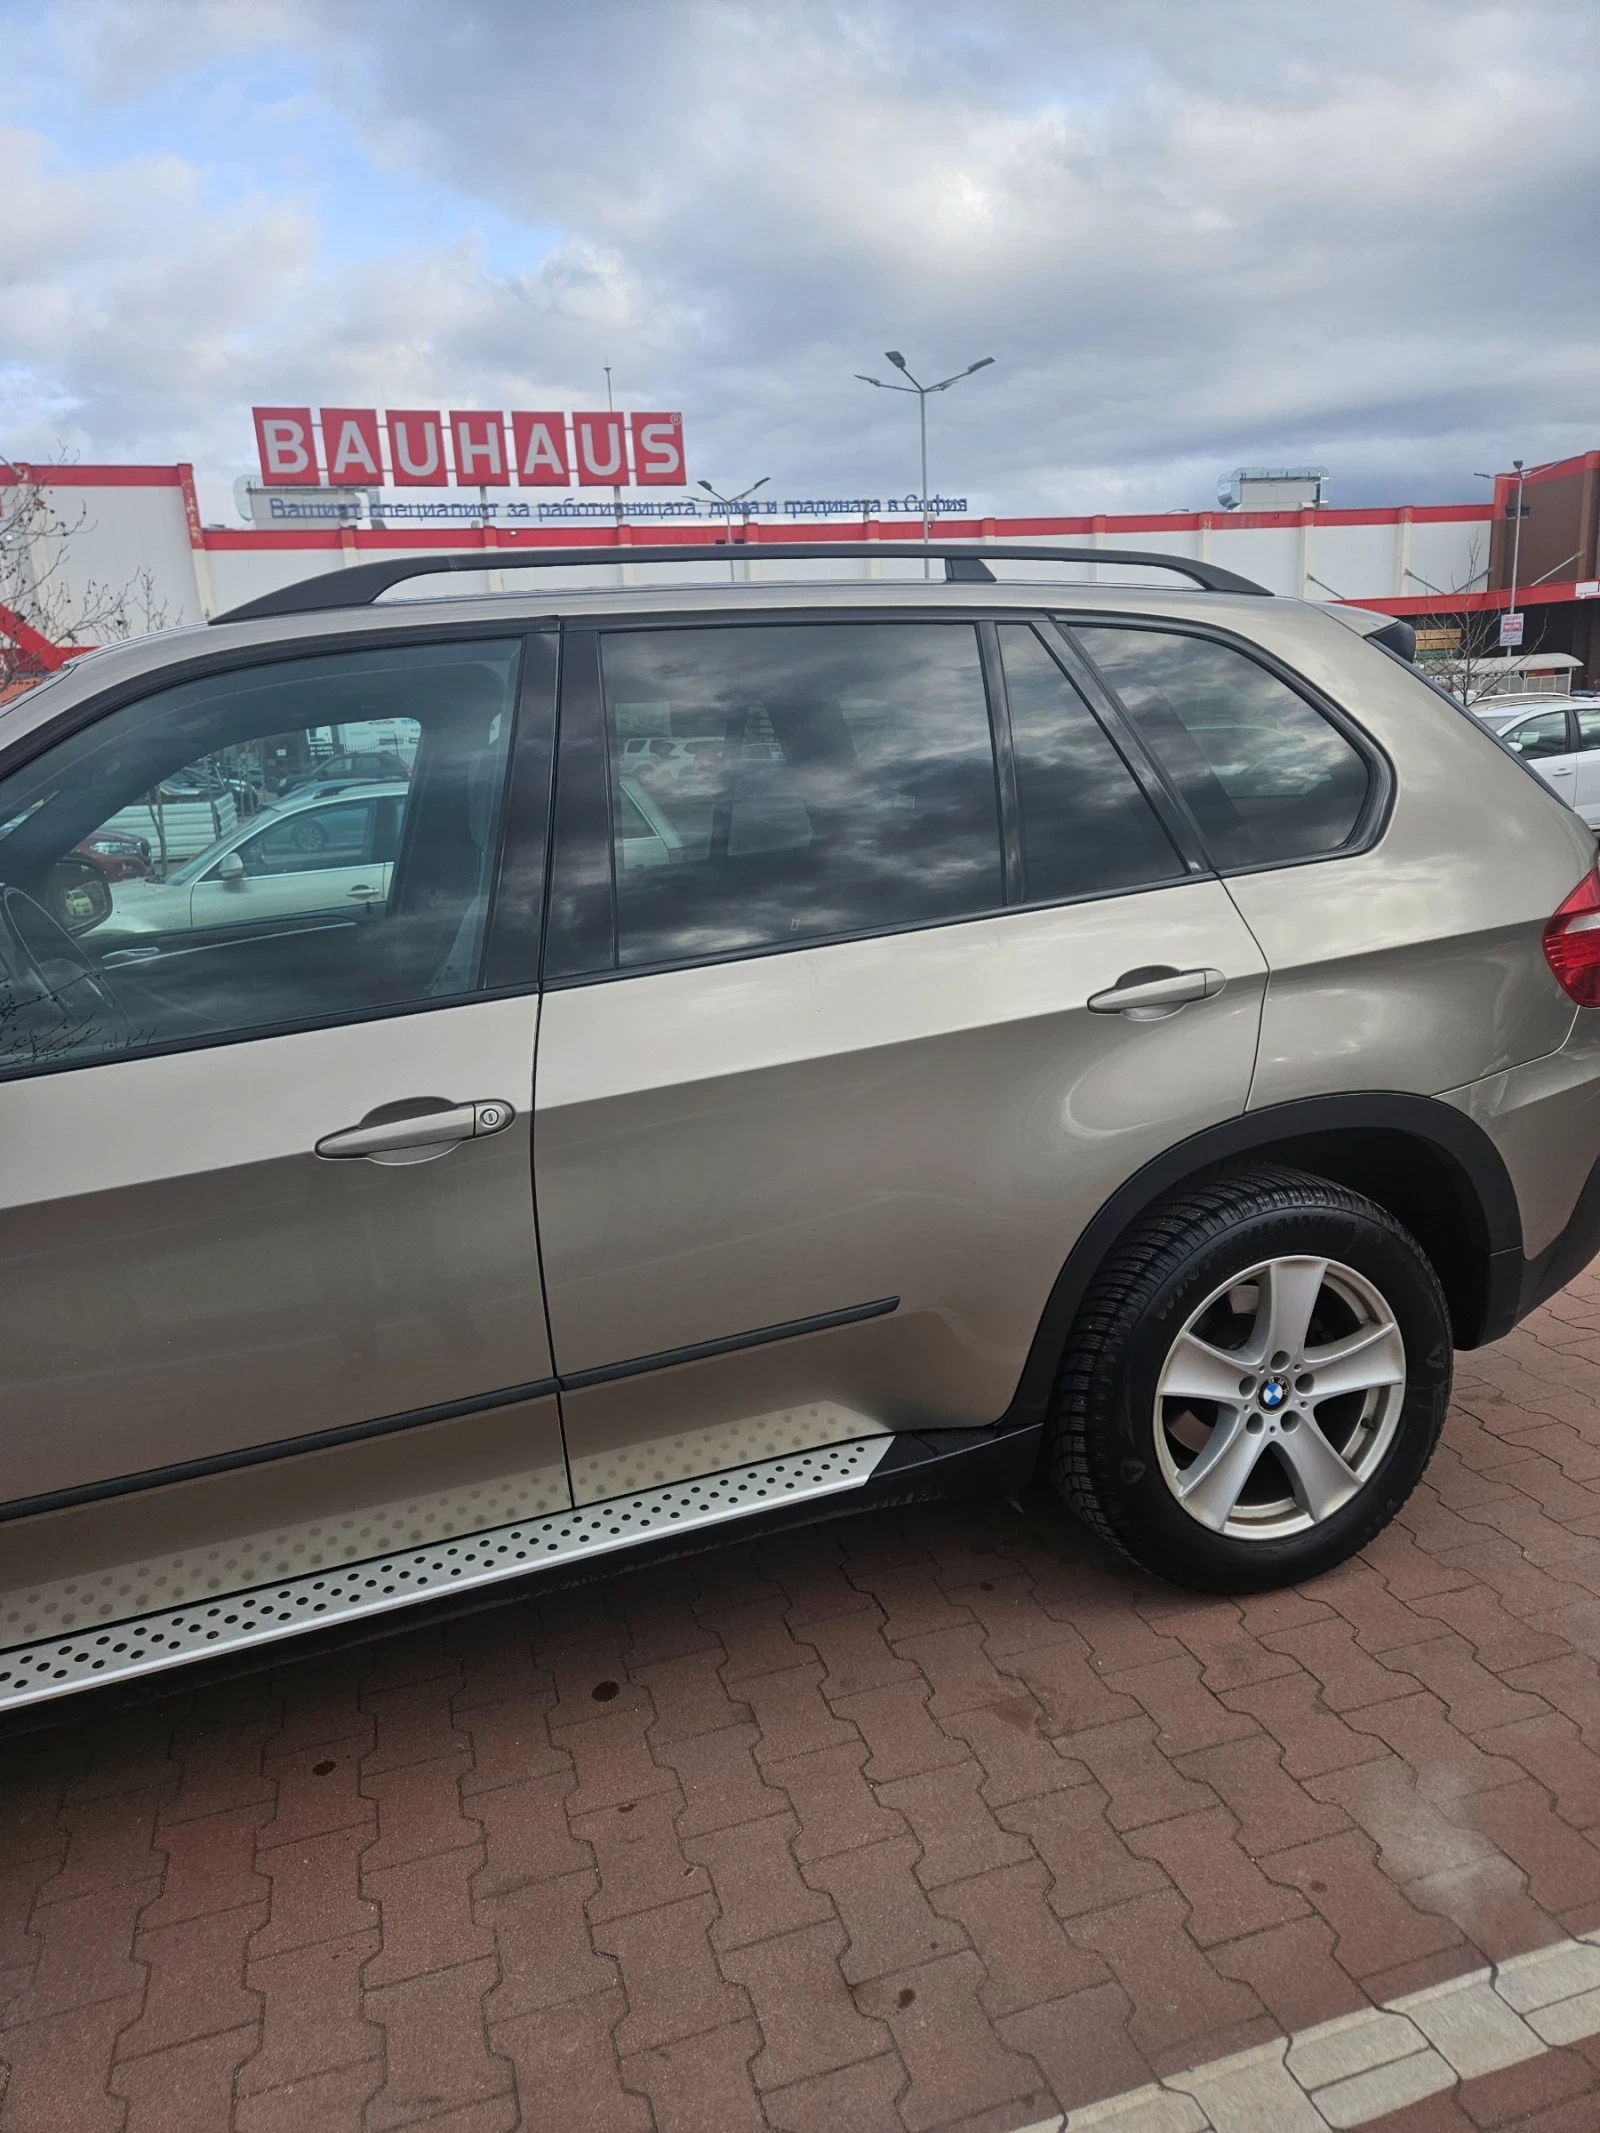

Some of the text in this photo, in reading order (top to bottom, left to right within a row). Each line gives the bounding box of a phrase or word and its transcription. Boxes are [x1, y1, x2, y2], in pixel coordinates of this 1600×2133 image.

[262, 418, 680, 477] BAUHAUS
[269, 497, 361, 518] Вашият
[369, 502, 498, 521] специалист
[507, 502, 530, 518] за
[708, 500, 759, 518] дома
[766, 500, 778, 514] и
[784, 499, 881, 518] градината
[887, 499, 899, 513] в
[904, 494, 968, 516] София
